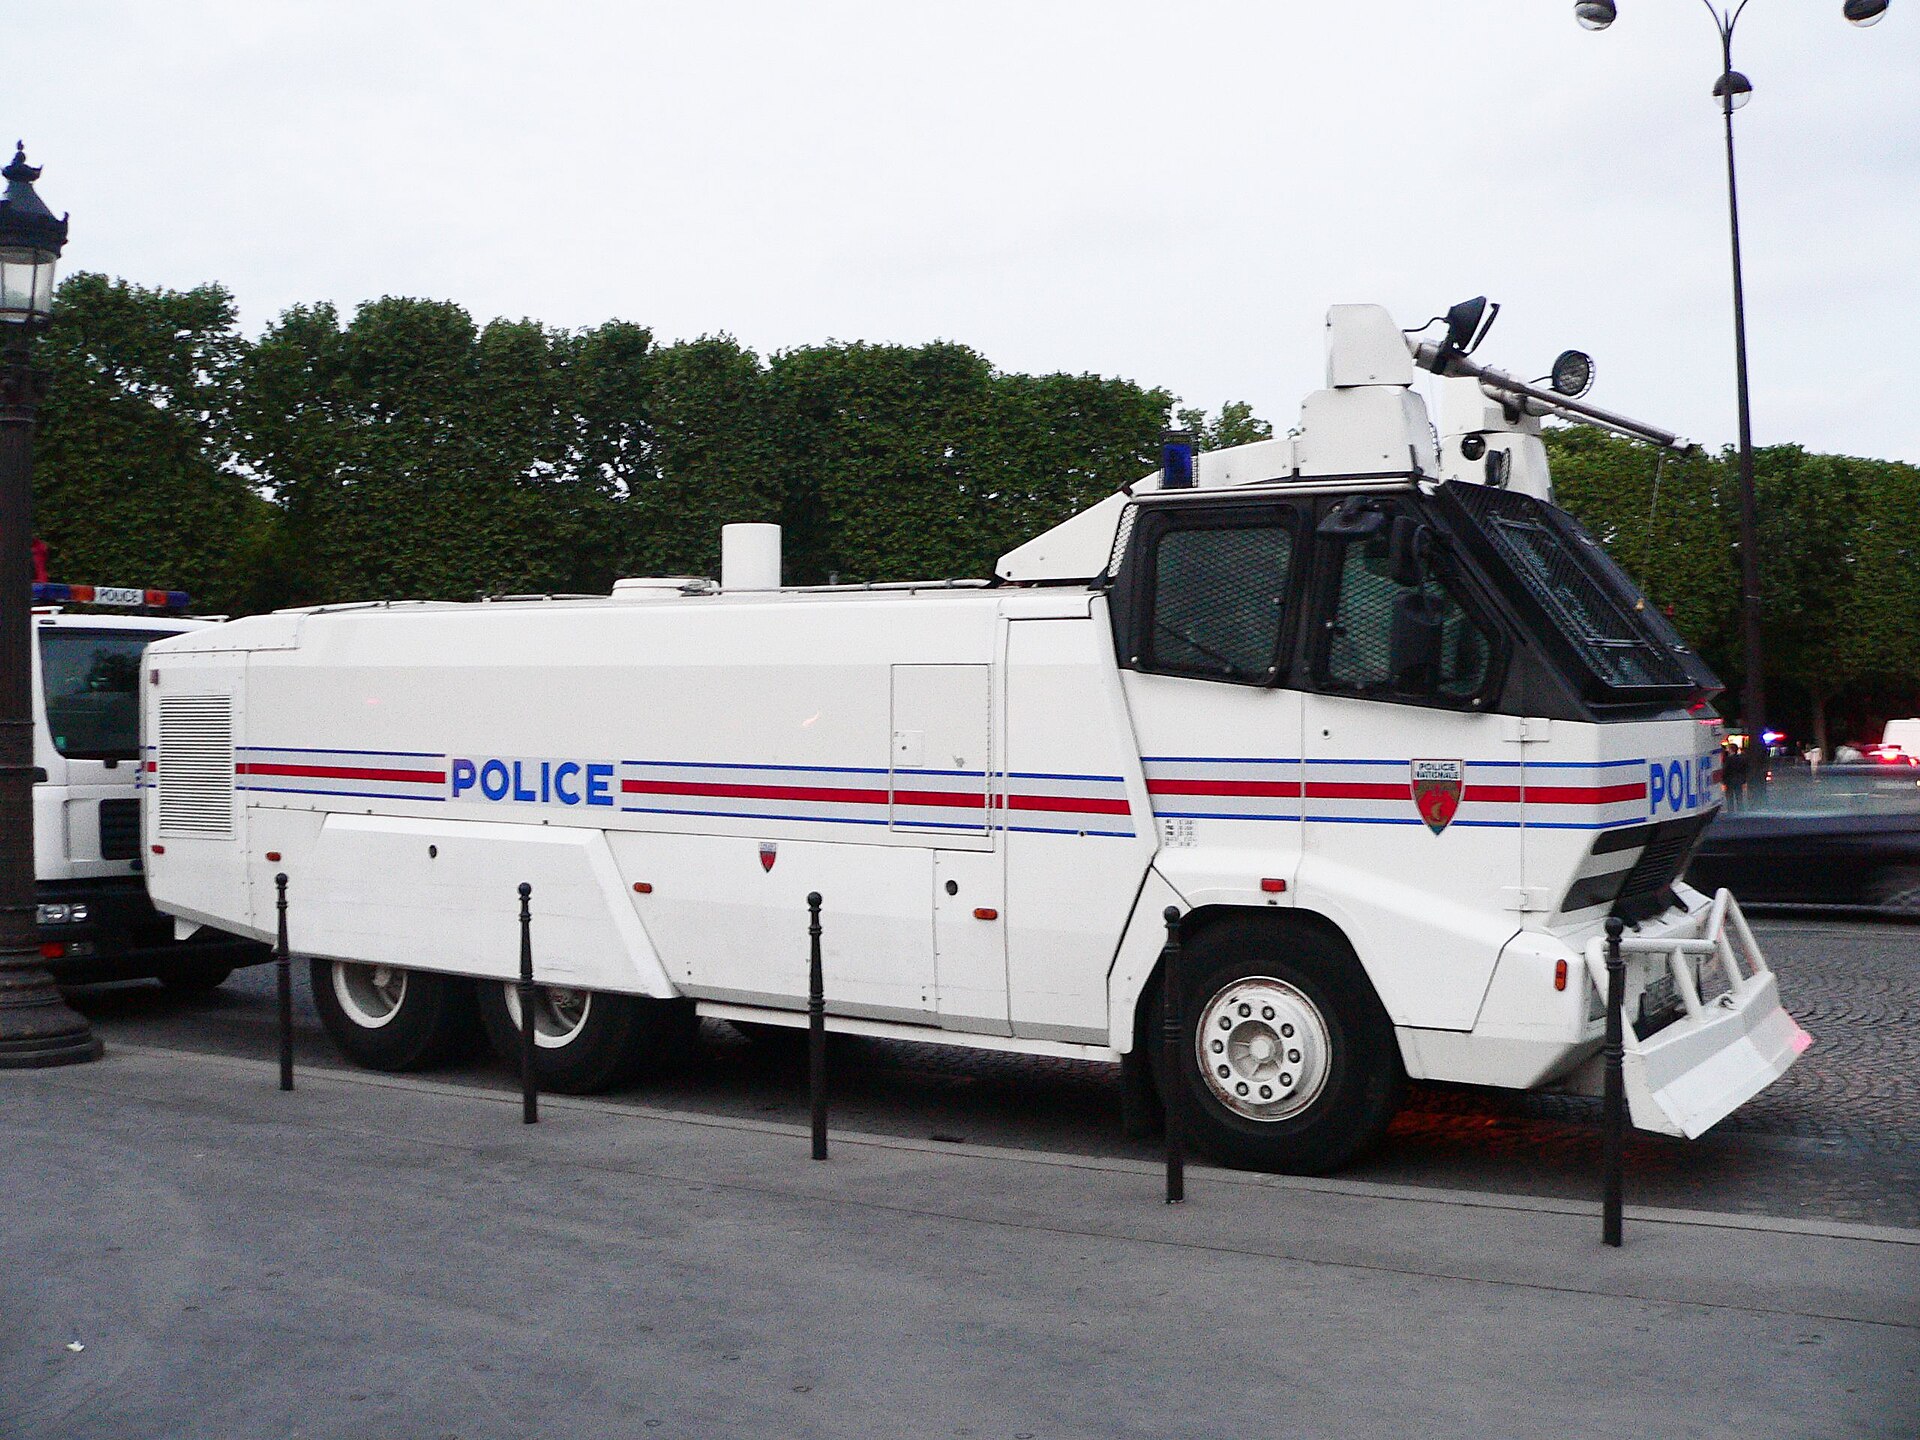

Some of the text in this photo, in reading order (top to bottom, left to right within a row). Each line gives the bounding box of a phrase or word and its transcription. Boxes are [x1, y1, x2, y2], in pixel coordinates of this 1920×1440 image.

[100, 589, 138, 603] POLICE
[1419, 763, 1457, 771] POLICE
[1416, 770, 1459, 779] NATIONALE
[452, 758, 614, 806] POLICE
